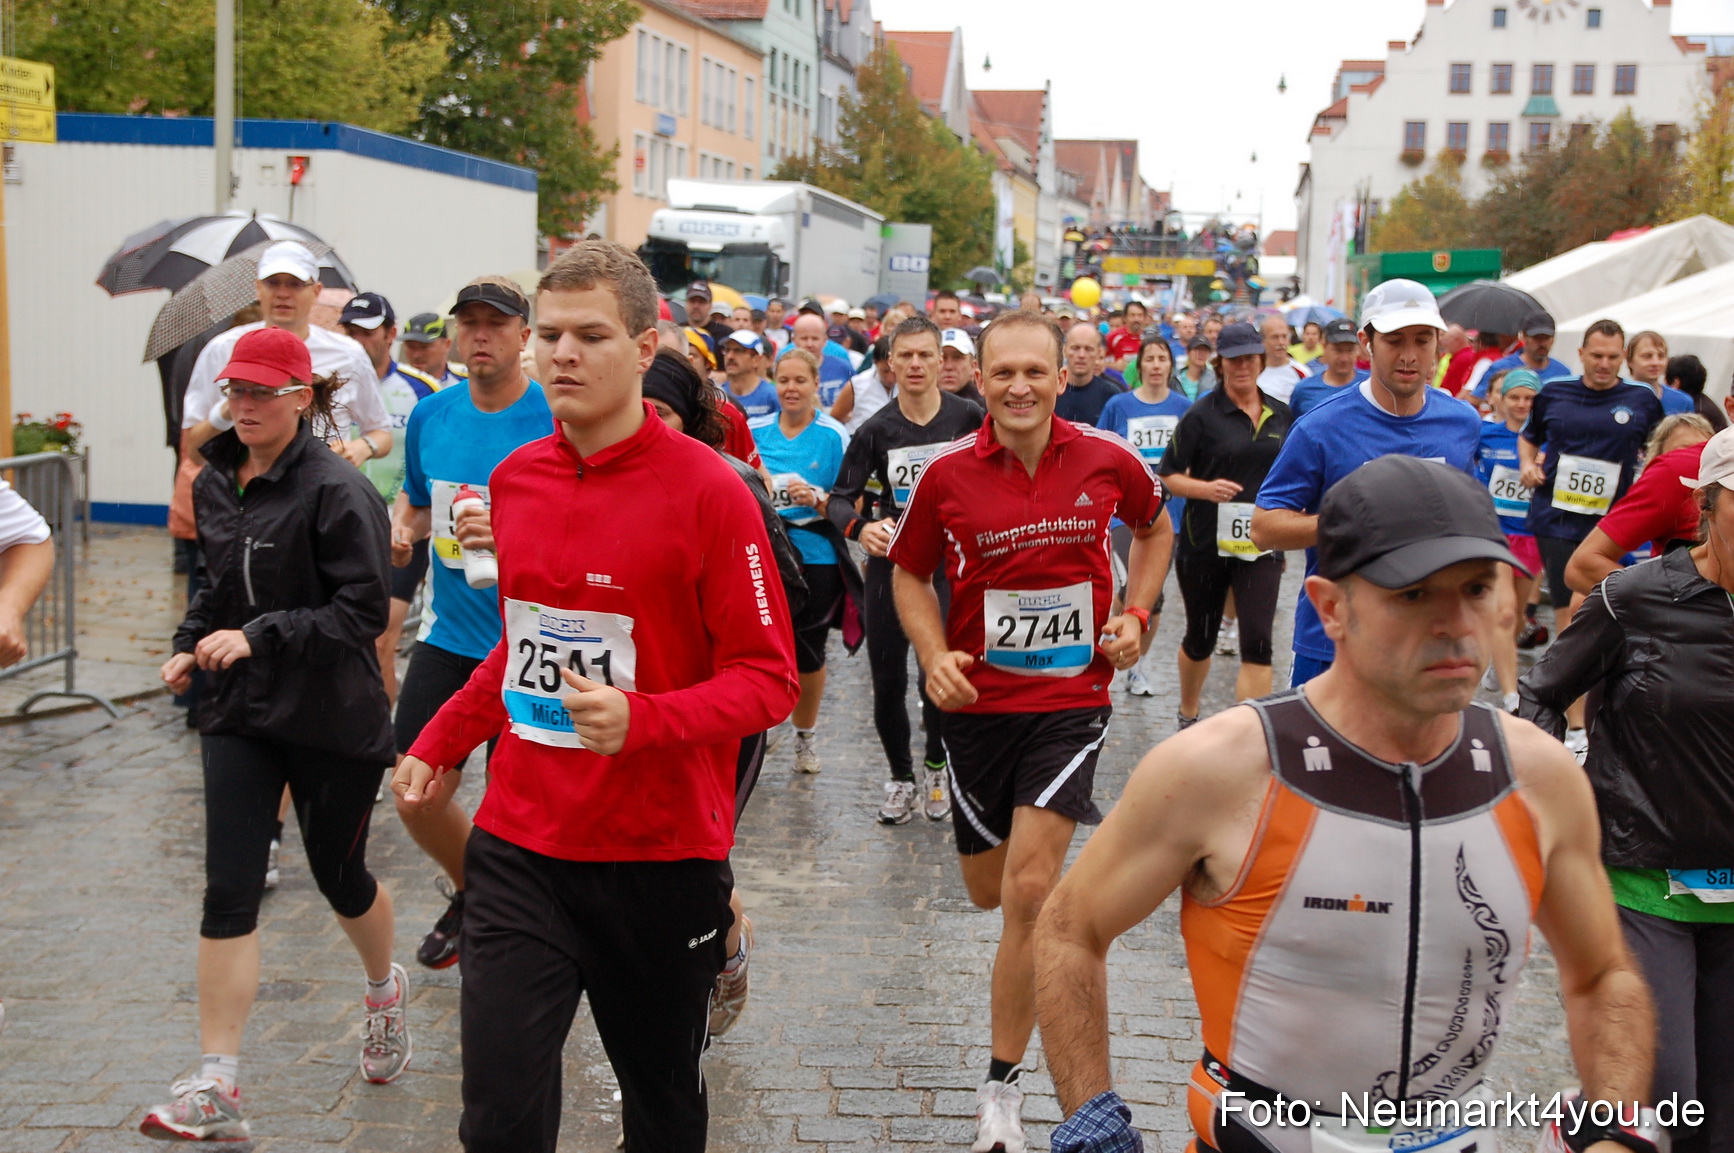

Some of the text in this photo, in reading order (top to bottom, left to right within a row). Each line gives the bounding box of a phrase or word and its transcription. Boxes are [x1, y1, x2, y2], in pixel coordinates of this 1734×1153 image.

[1569, 472, 1605, 495] 568
[976, 516, 1096, 547] Filmproduktion
[745, 543, 773, 626] SIEMENS
[997, 609, 1083, 648] 2744
[1025, 655, 1053, 666] Max
[532, 702, 574, 727] Mich
[1303, 894, 1391, 914] IRONMAN
